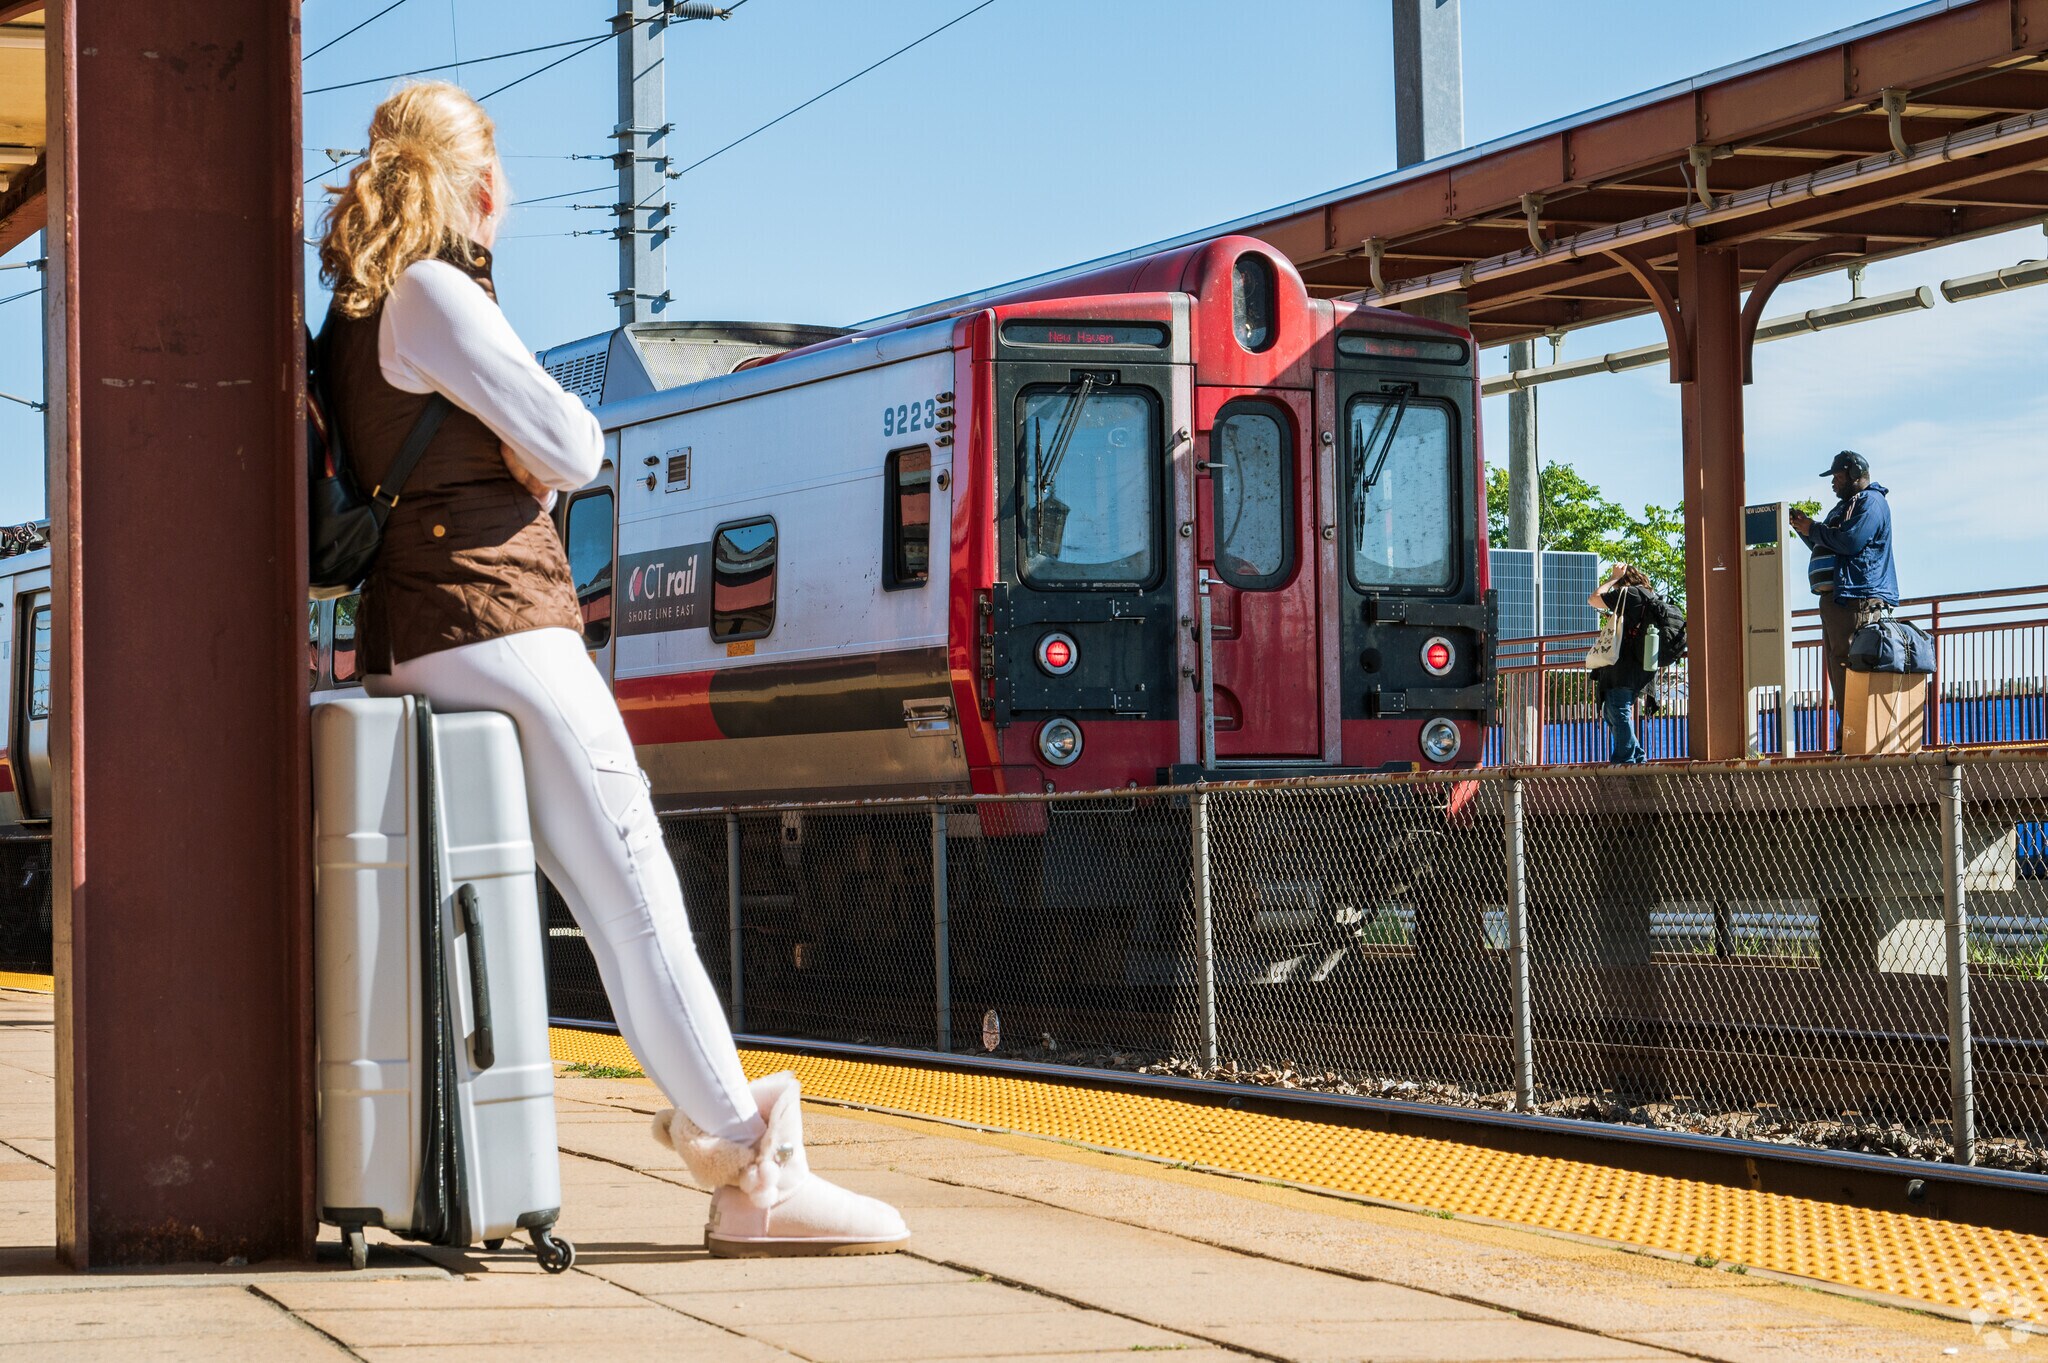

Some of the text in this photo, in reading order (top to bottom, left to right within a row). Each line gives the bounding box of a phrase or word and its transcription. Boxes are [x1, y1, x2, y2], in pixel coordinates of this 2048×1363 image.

[1048, 331, 1114, 344] New Haven
[883, 398, 936, 437] 9223
[628, 604, 695, 623] SHORE LINE EAST
